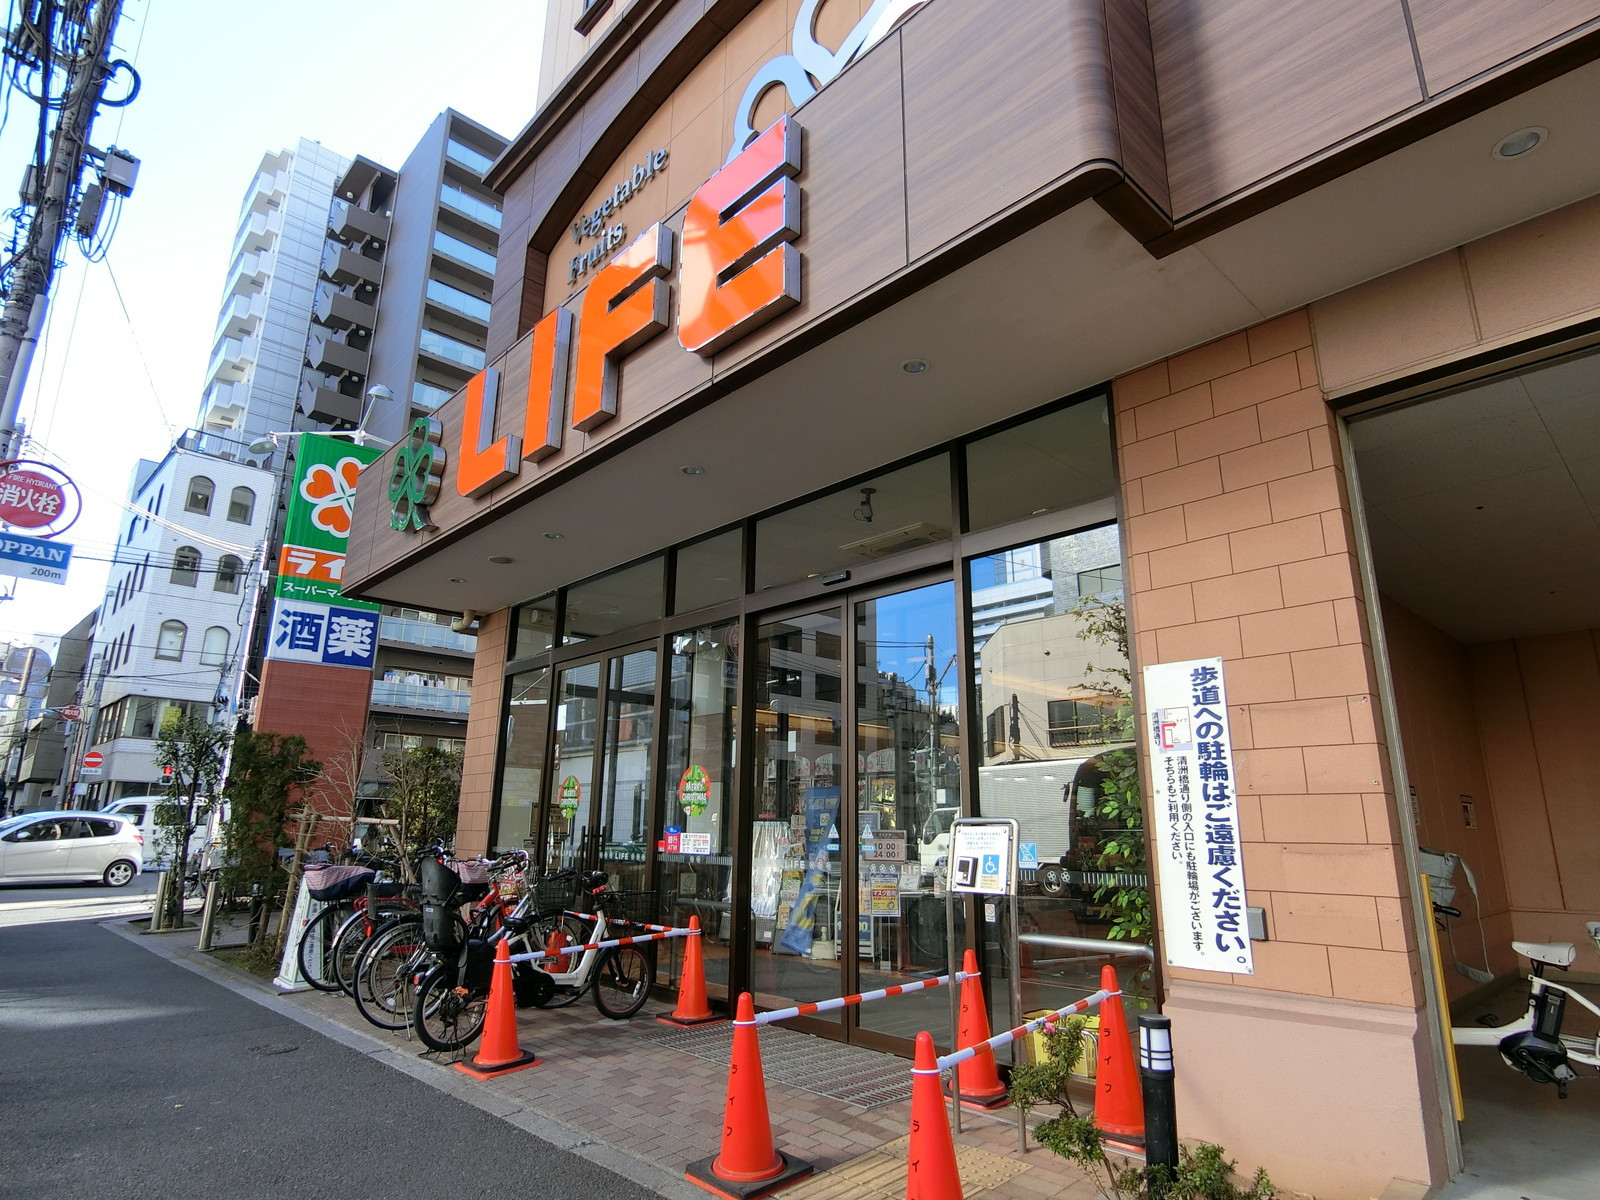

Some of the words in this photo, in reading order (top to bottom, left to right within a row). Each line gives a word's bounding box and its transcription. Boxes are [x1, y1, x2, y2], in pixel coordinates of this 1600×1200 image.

[570, 148, 668, 244] Vegetable
[567, 222, 624, 285] Fruits
[457, 113, 801, 498] LIFE
[0, 482, 61, 516] 消火栓
[8, 473, 25, 483] FIRE
[26, 477, 58, 490] HYDRANT
[0, 538, 66, 562] PPAN
[31, 567, 61, 579] 200m
[275, 608, 325, 652] 酒
[327, 615, 374, 658] 薬
[1164, 756, 1183, 865] そちらもご利用ください。
[1190, 665, 1247, 964] 歩道への駐輪はご遠慮ください。
[785, 861, 806, 869] LIFE
[901, 865, 927, 876] LIFE
[1177, 755, 1205, 956] 清洲橋通り側の入口にも駐輪場がございます。
[1103, 1028, 1112, 1093] ライフ
[726, 1064, 738, 1137] ライフ
